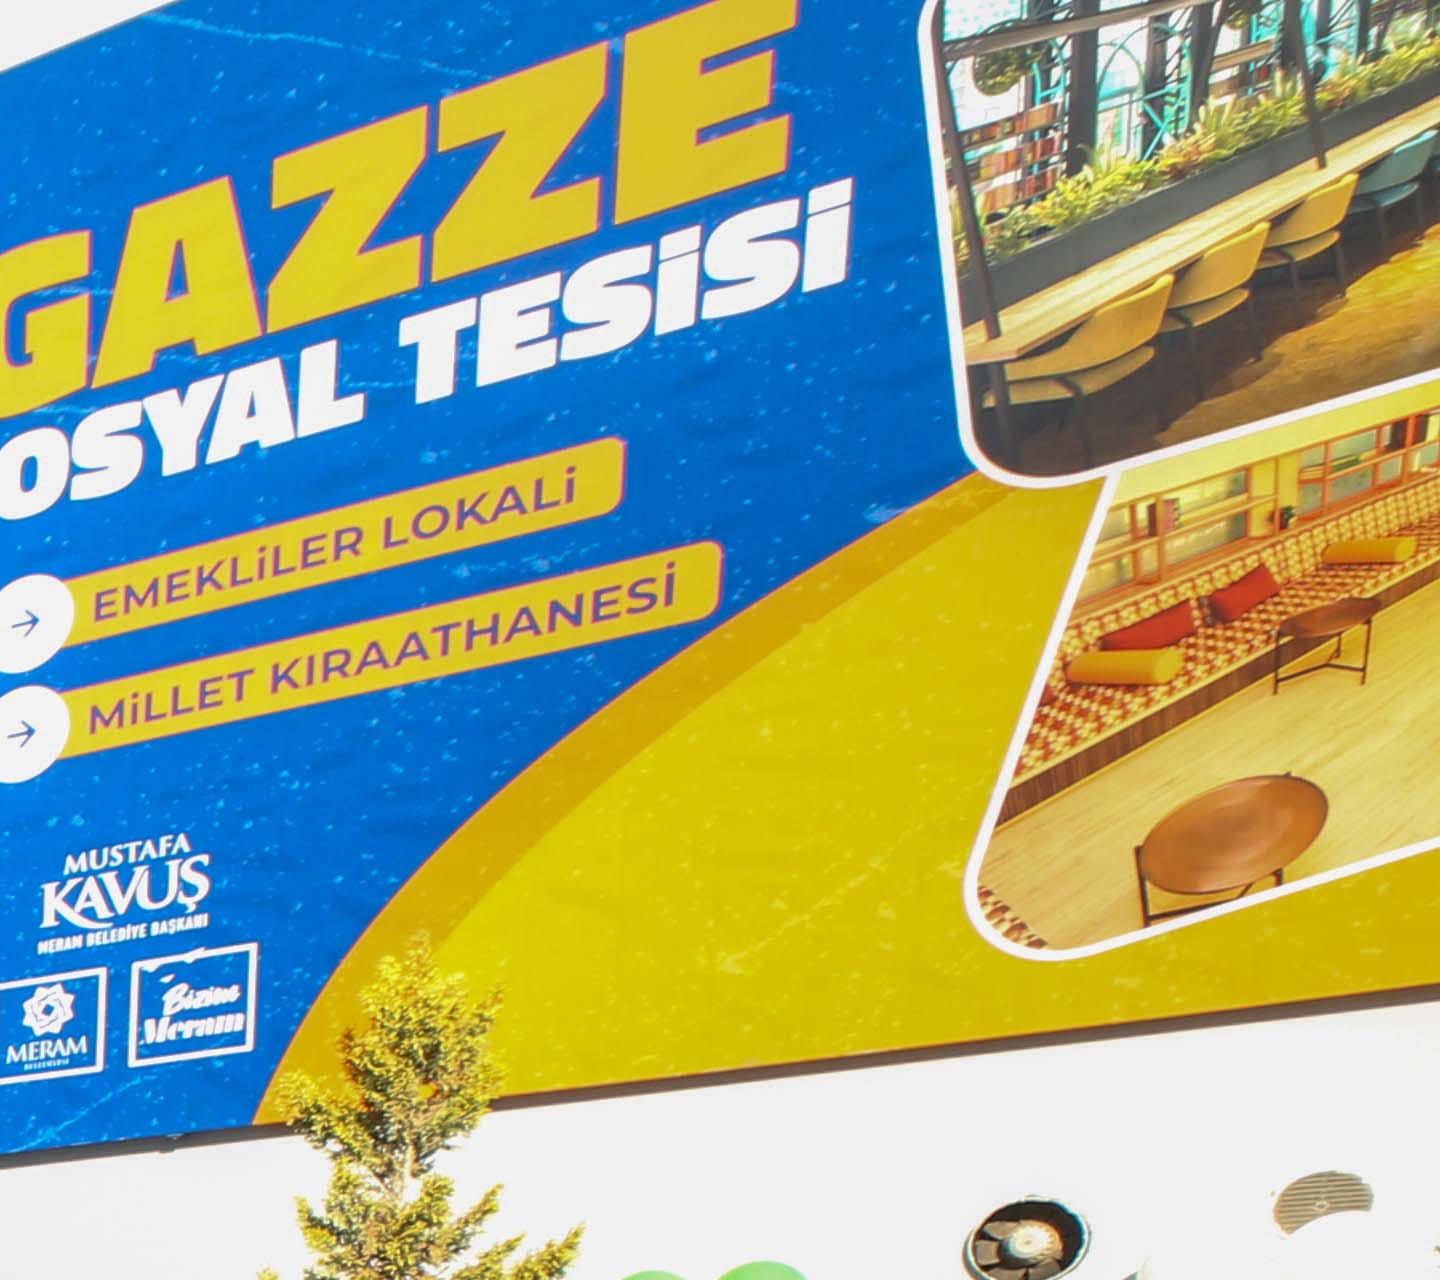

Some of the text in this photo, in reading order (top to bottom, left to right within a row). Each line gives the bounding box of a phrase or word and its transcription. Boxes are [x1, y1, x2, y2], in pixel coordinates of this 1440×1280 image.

[64, 832, 191, 875] MUSTAFA
[39, 853, 211, 929] KAVUŞ
[37, 935, 84, 955] MERAM
[5, 1035, 88, 1064] MERAM
